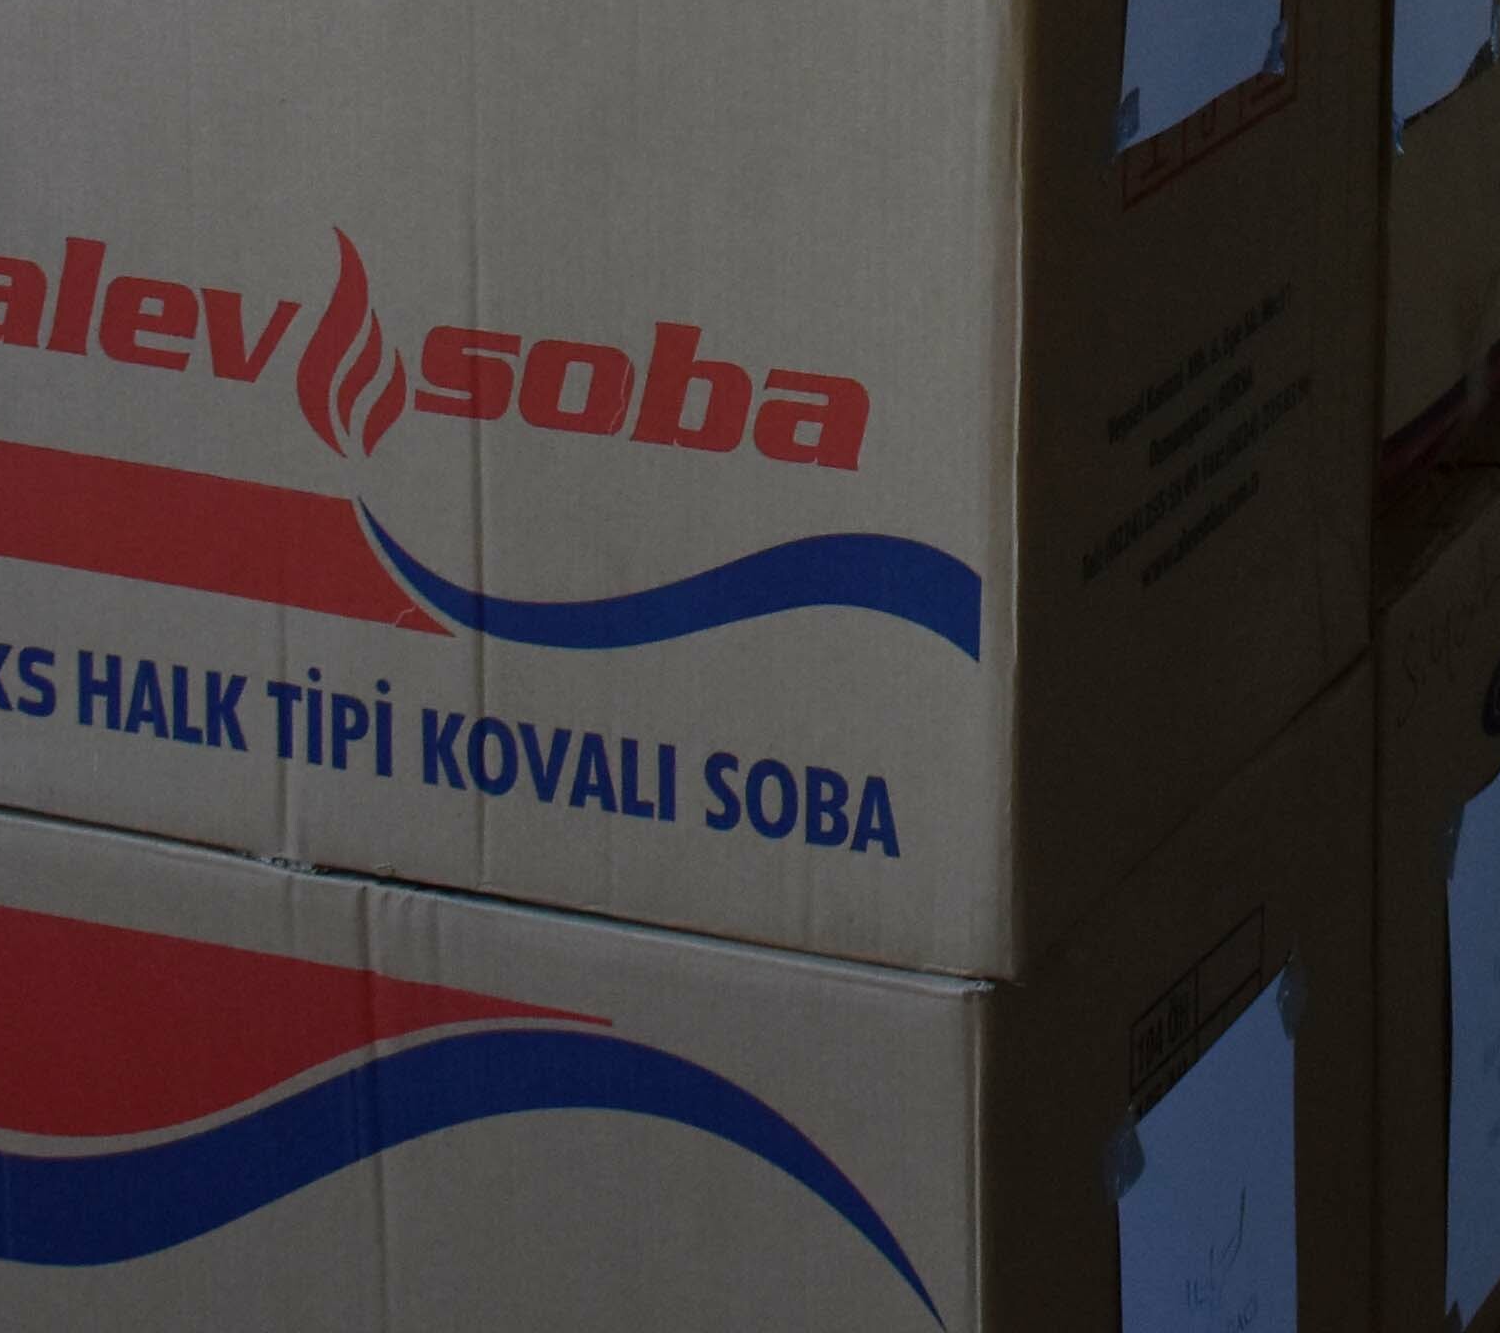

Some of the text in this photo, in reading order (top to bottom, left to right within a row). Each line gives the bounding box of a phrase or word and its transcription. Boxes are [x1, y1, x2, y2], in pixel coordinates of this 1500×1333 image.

[414, 320, 871, 473] soba
[77, 647, 250, 755] HALK
[267, 665, 393, 780] TİPİ
[421, 707, 676, 824] KOVALI
[703, 751, 901, 859] SOBA
